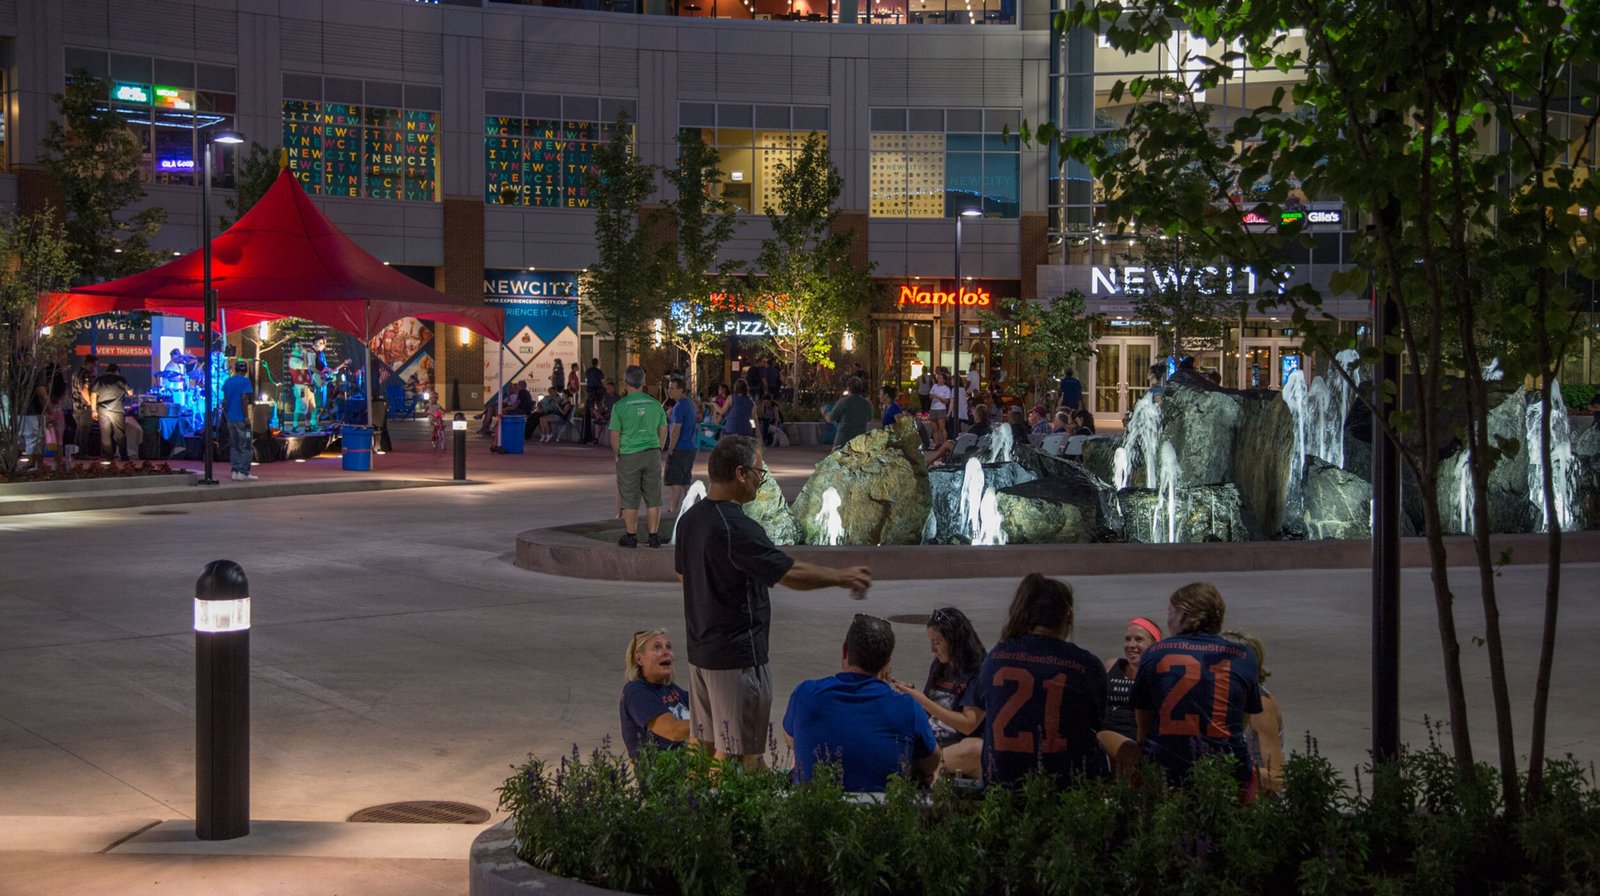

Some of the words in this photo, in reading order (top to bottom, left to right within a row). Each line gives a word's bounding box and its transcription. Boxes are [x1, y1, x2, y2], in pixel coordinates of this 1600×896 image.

[483, 279, 573, 295] NEWCITY
[1091, 265, 1296, 295] NEWCITY
[900, 285, 990, 306] Nando's
[506, 307, 539, 317] RIENCE
[541, 308, 549, 317] IT
[551, 309, 569, 318] ALL
[723, 320, 775, 336] PIZZA
[108, 333, 153, 341] SERIE
[96, 346, 115, 355] VERY
[1156, 653, 1233, 739] 21
[992, 666, 1068, 753] 21
